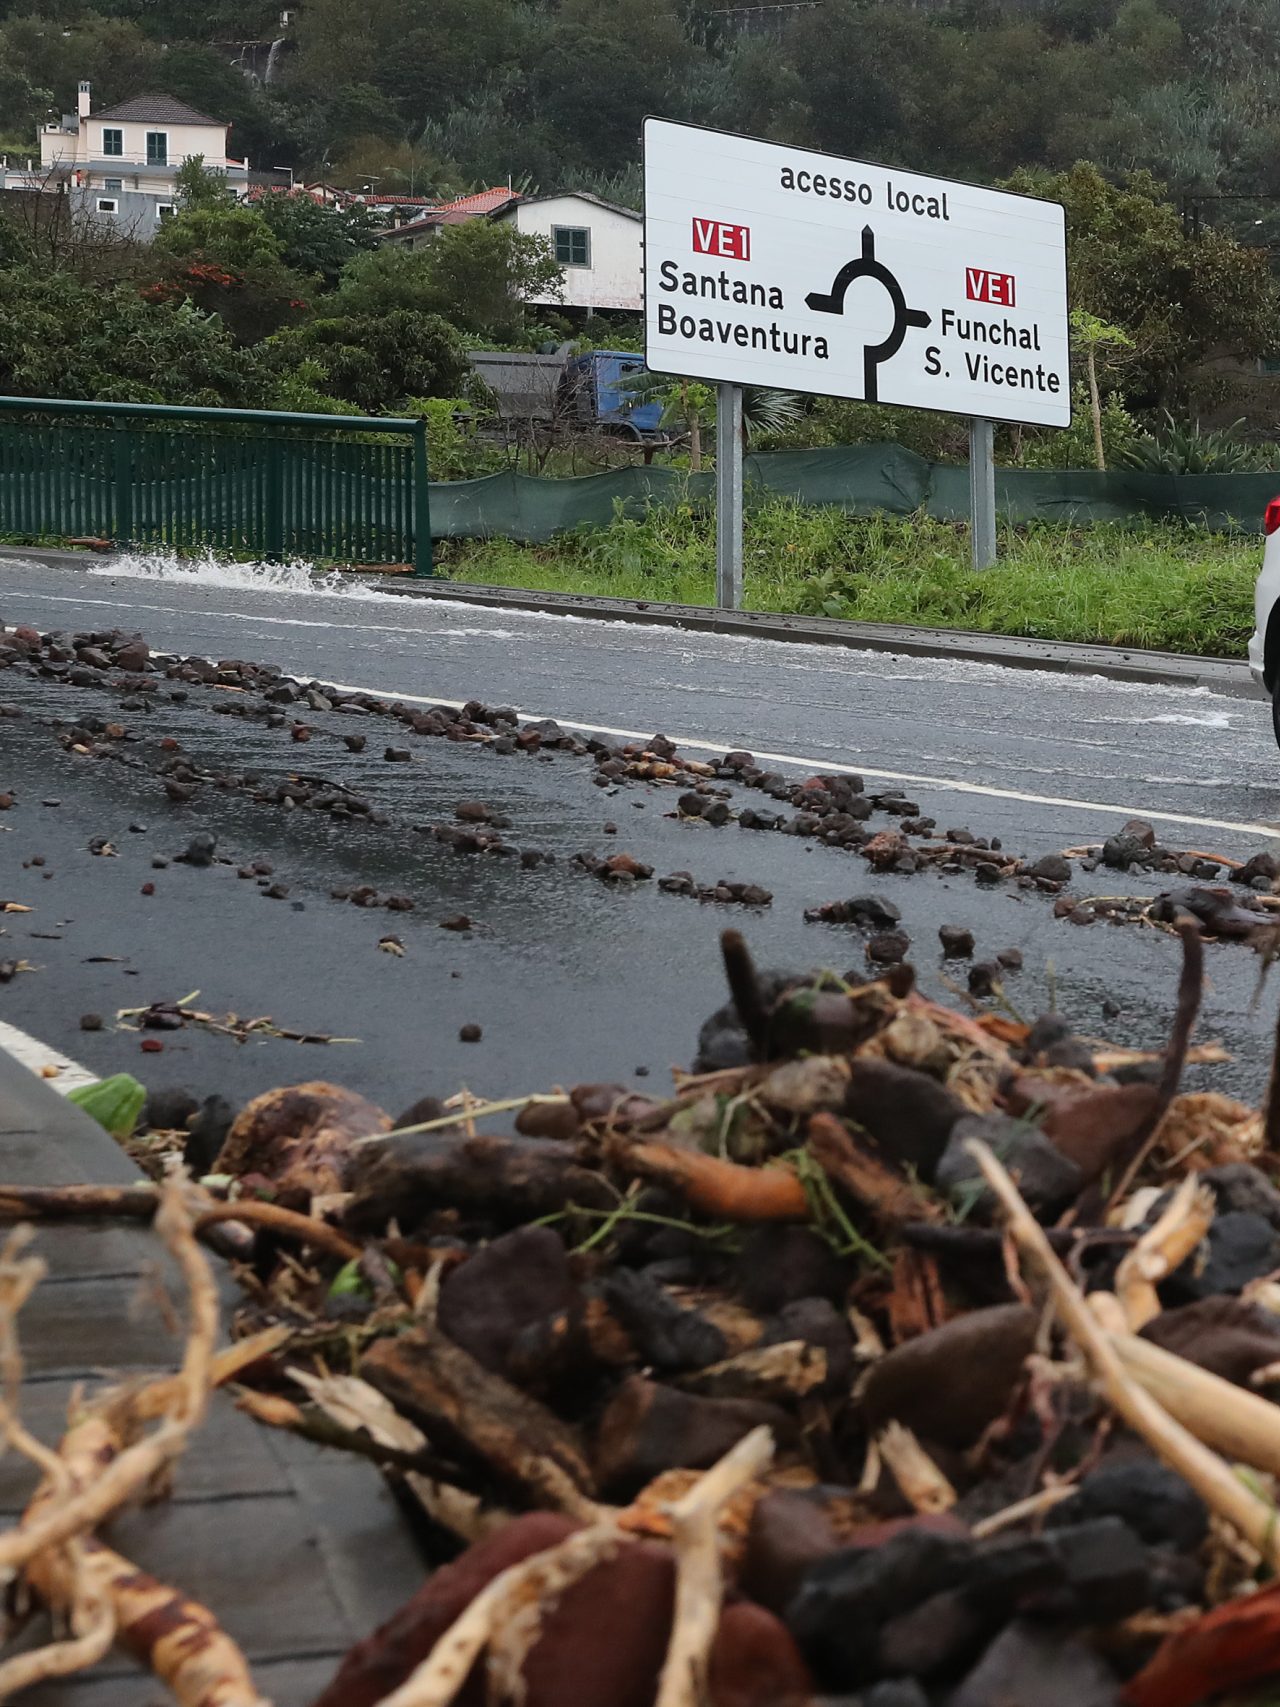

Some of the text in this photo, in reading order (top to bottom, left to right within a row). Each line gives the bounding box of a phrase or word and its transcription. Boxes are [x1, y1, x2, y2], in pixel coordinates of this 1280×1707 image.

[781, 168, 949, 220] acesso local
[694, 219, 749, 260] VE1
[659, 261, 783, 310] Santana
[968, 270, 1015, 306] VE1
[659, 304, 828, 359] Boaventura
[942, 309, 1040, 351] Funchal
[924, 347, 1059, 394] S. Vicente
